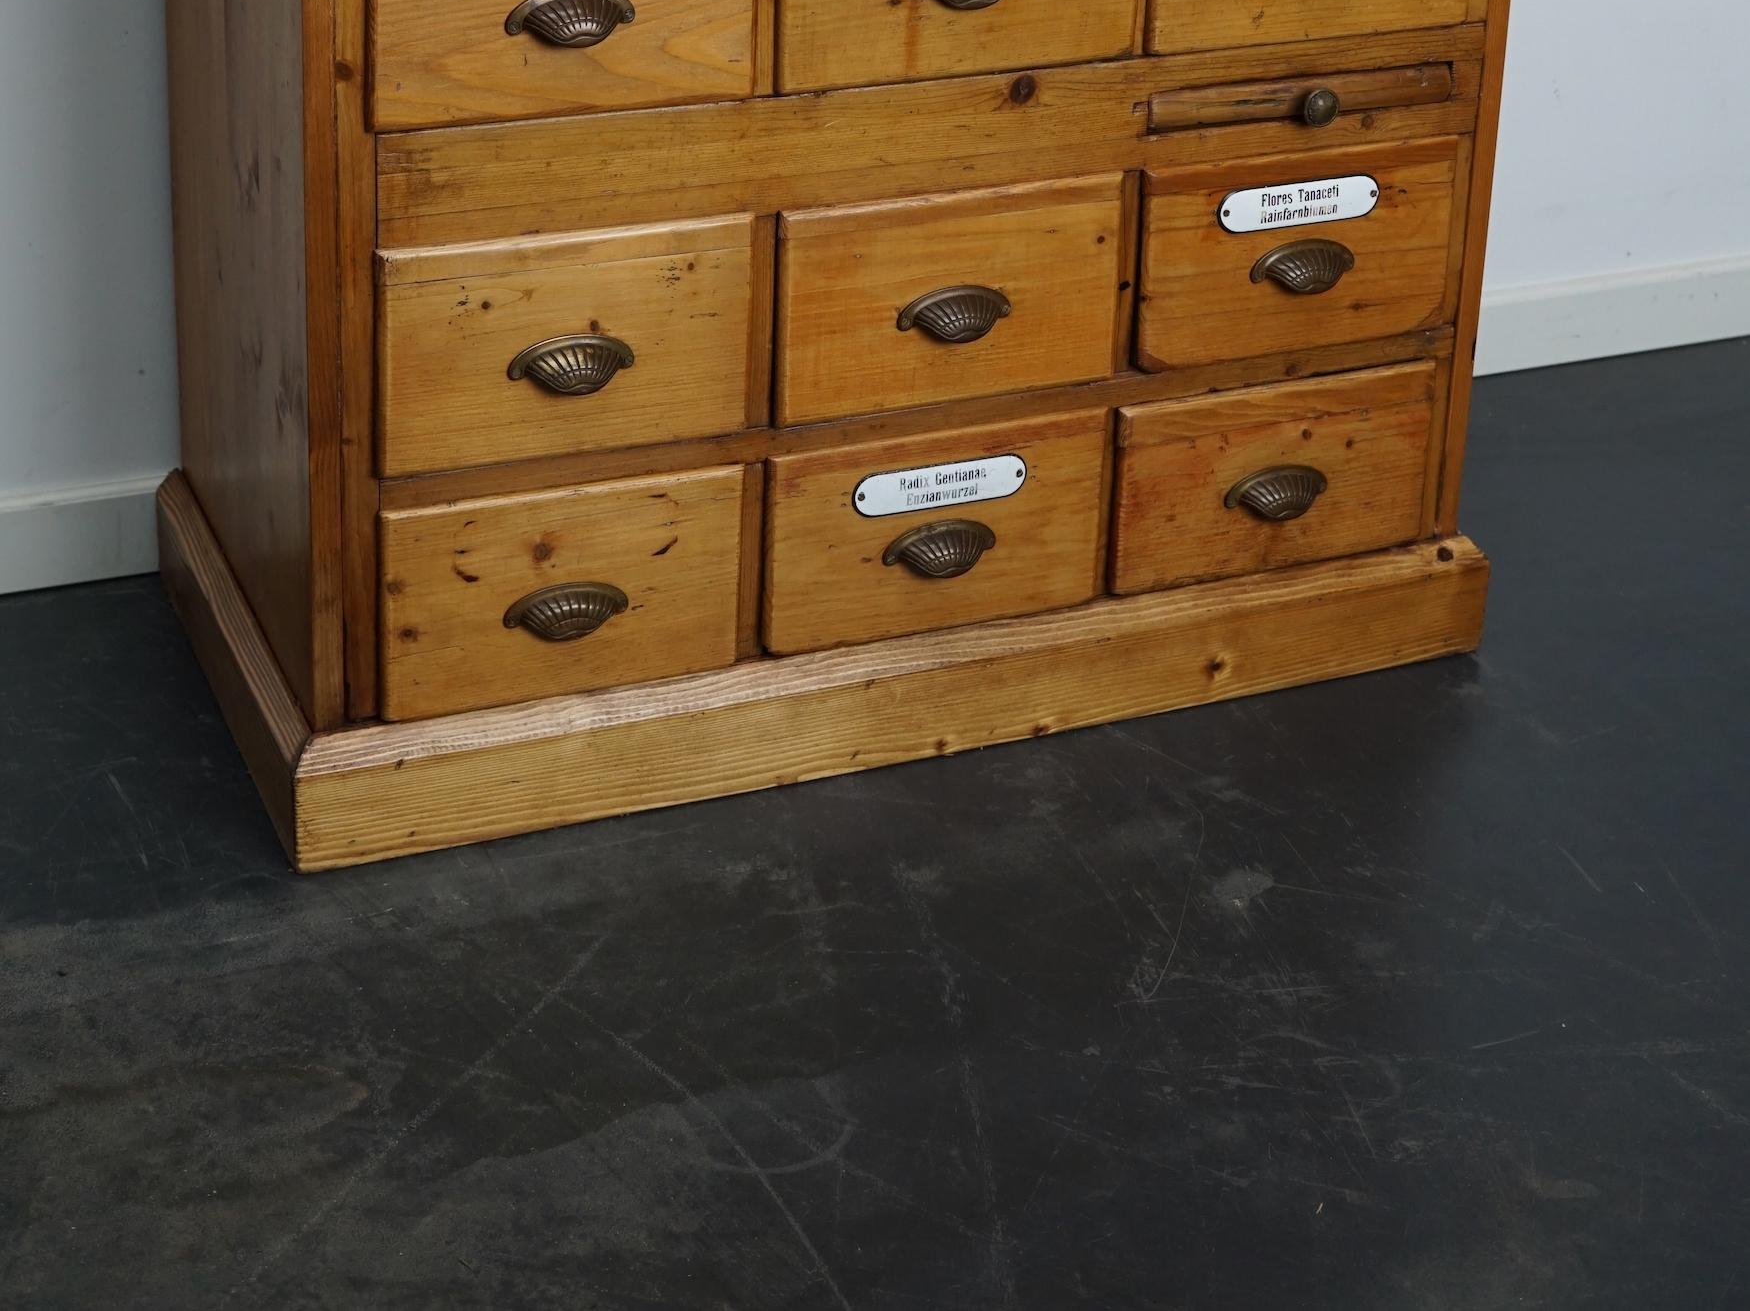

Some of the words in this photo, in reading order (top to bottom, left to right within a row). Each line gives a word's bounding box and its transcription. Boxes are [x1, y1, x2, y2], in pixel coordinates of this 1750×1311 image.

[1261, 192, 1293, 208] Flores
[1297, 184, 1340, 202] Tanaceti
[1260, 204, 1338, 224] Rainfarnblumen
[899, 476, 930, 491] Radix
[906, 483, 979, 506] Enzianwurzel
